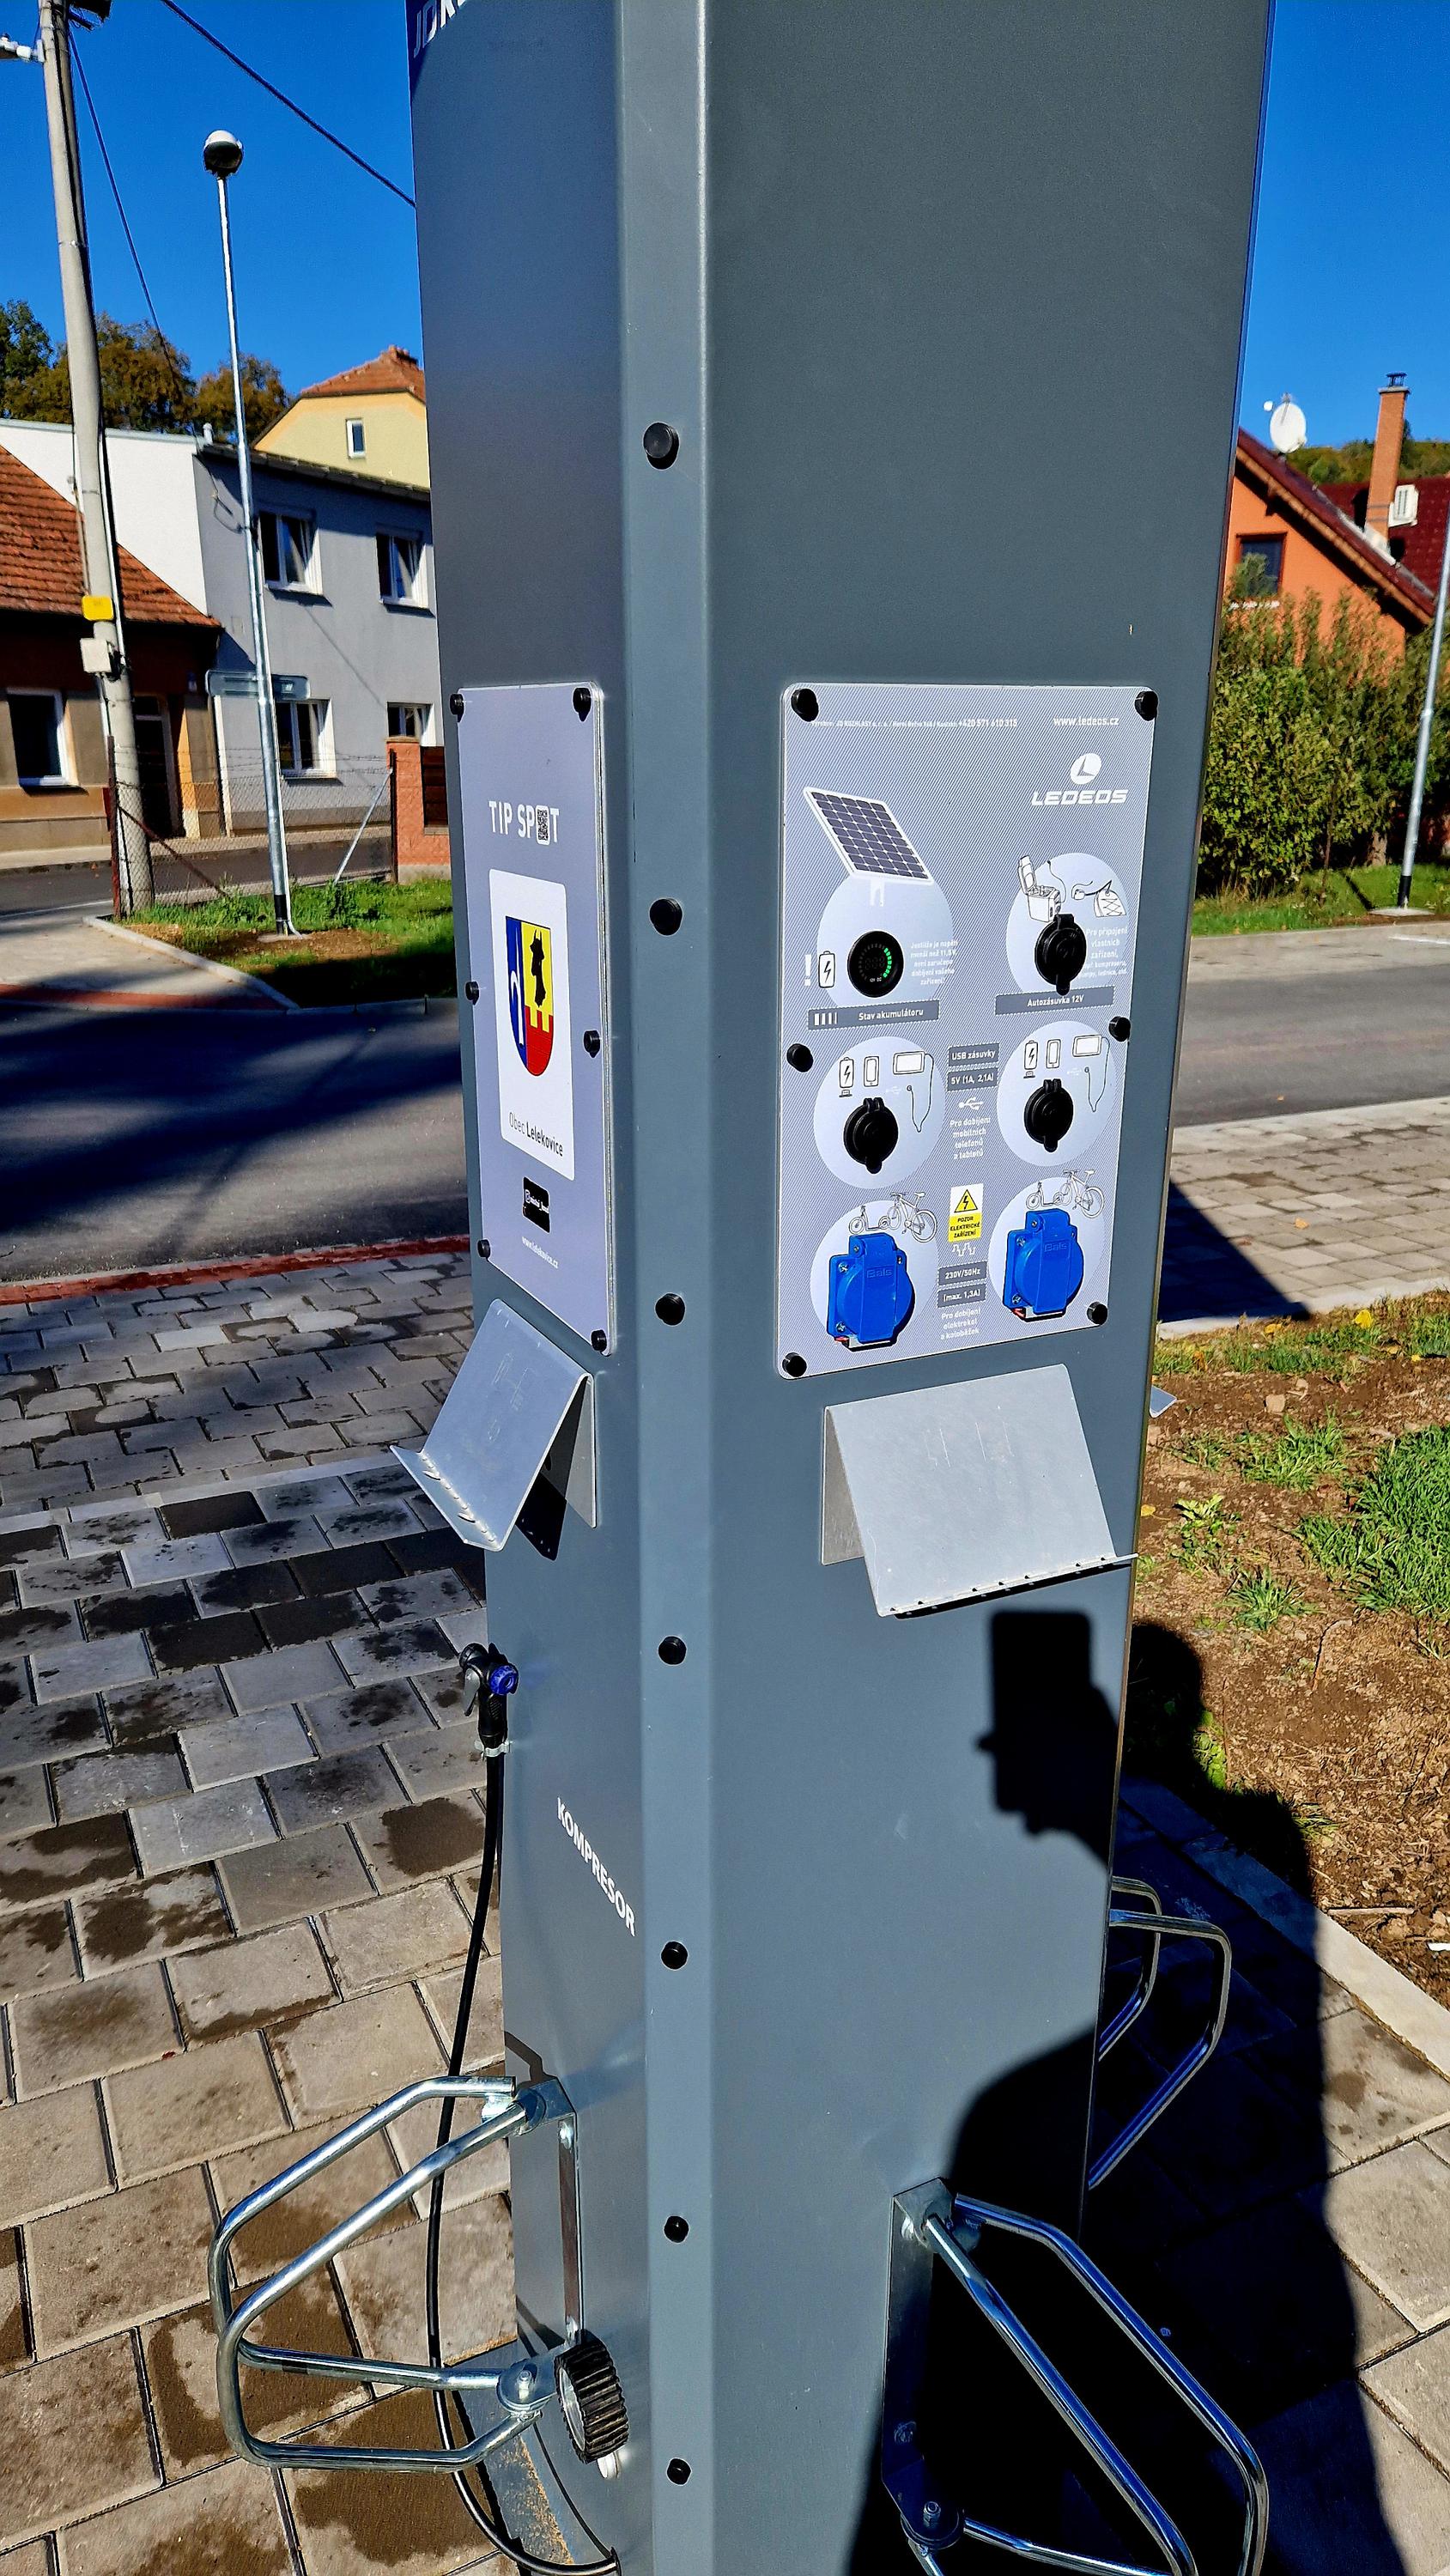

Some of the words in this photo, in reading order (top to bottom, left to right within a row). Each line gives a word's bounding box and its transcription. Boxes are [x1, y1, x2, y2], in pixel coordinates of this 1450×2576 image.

[959, 719, 974, 727] +420
[1053, 716, 1119, 726] www.ledeos.cz
[1031, 789, 1129, 805] LEDEOS
[488, 800, 513, 835] TIP
[1027, 996, 1070, 1007] Autozásuvka
[1072, 994, 1084, 1003] 12V
[858, 1012, 875, 1021] Stav
[877, 1008, 924, 1019] akumulátoru
[951, 1052, 967, 1060] USB
[968, 1049, 996, 1059] zásuvky
[951, 1076, 961, 1084] 5V
[509, 1112, 525, 1134] Obec
[526, 1121, 563, 1157] Lelekovice
[1044, 1242, 1067, 1253] Bals
[866, 1267, 893, 1279] Bals
[945, 1267, 980, 1279] 230V/50Hz
[557, 1796, 636, 1937] KOMPRESOR
